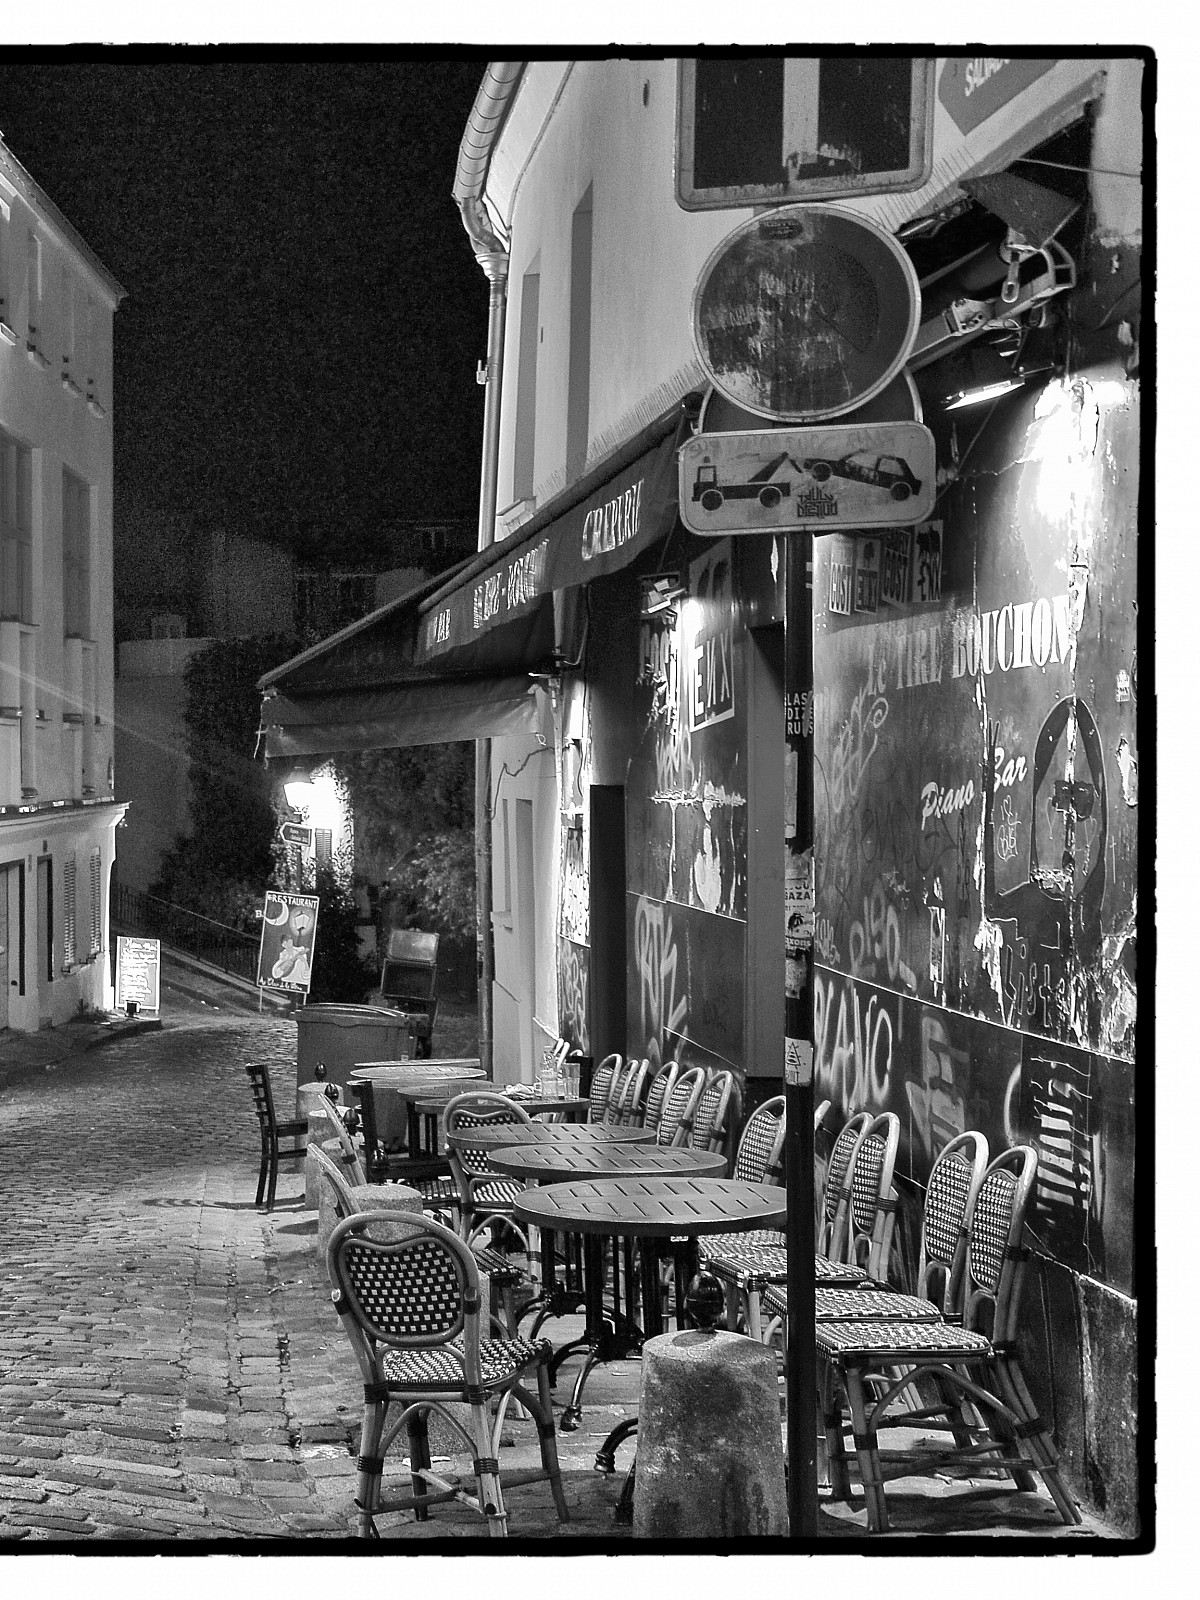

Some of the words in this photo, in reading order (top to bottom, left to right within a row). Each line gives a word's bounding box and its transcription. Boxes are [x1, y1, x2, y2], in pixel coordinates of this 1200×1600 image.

[951, 595, 1074, 679] BOUCHON
[920, 779, 975, 831] Piano
[272, 894, 318, 910] RESTAURANT
[785, 891, 812, 900] AZA
